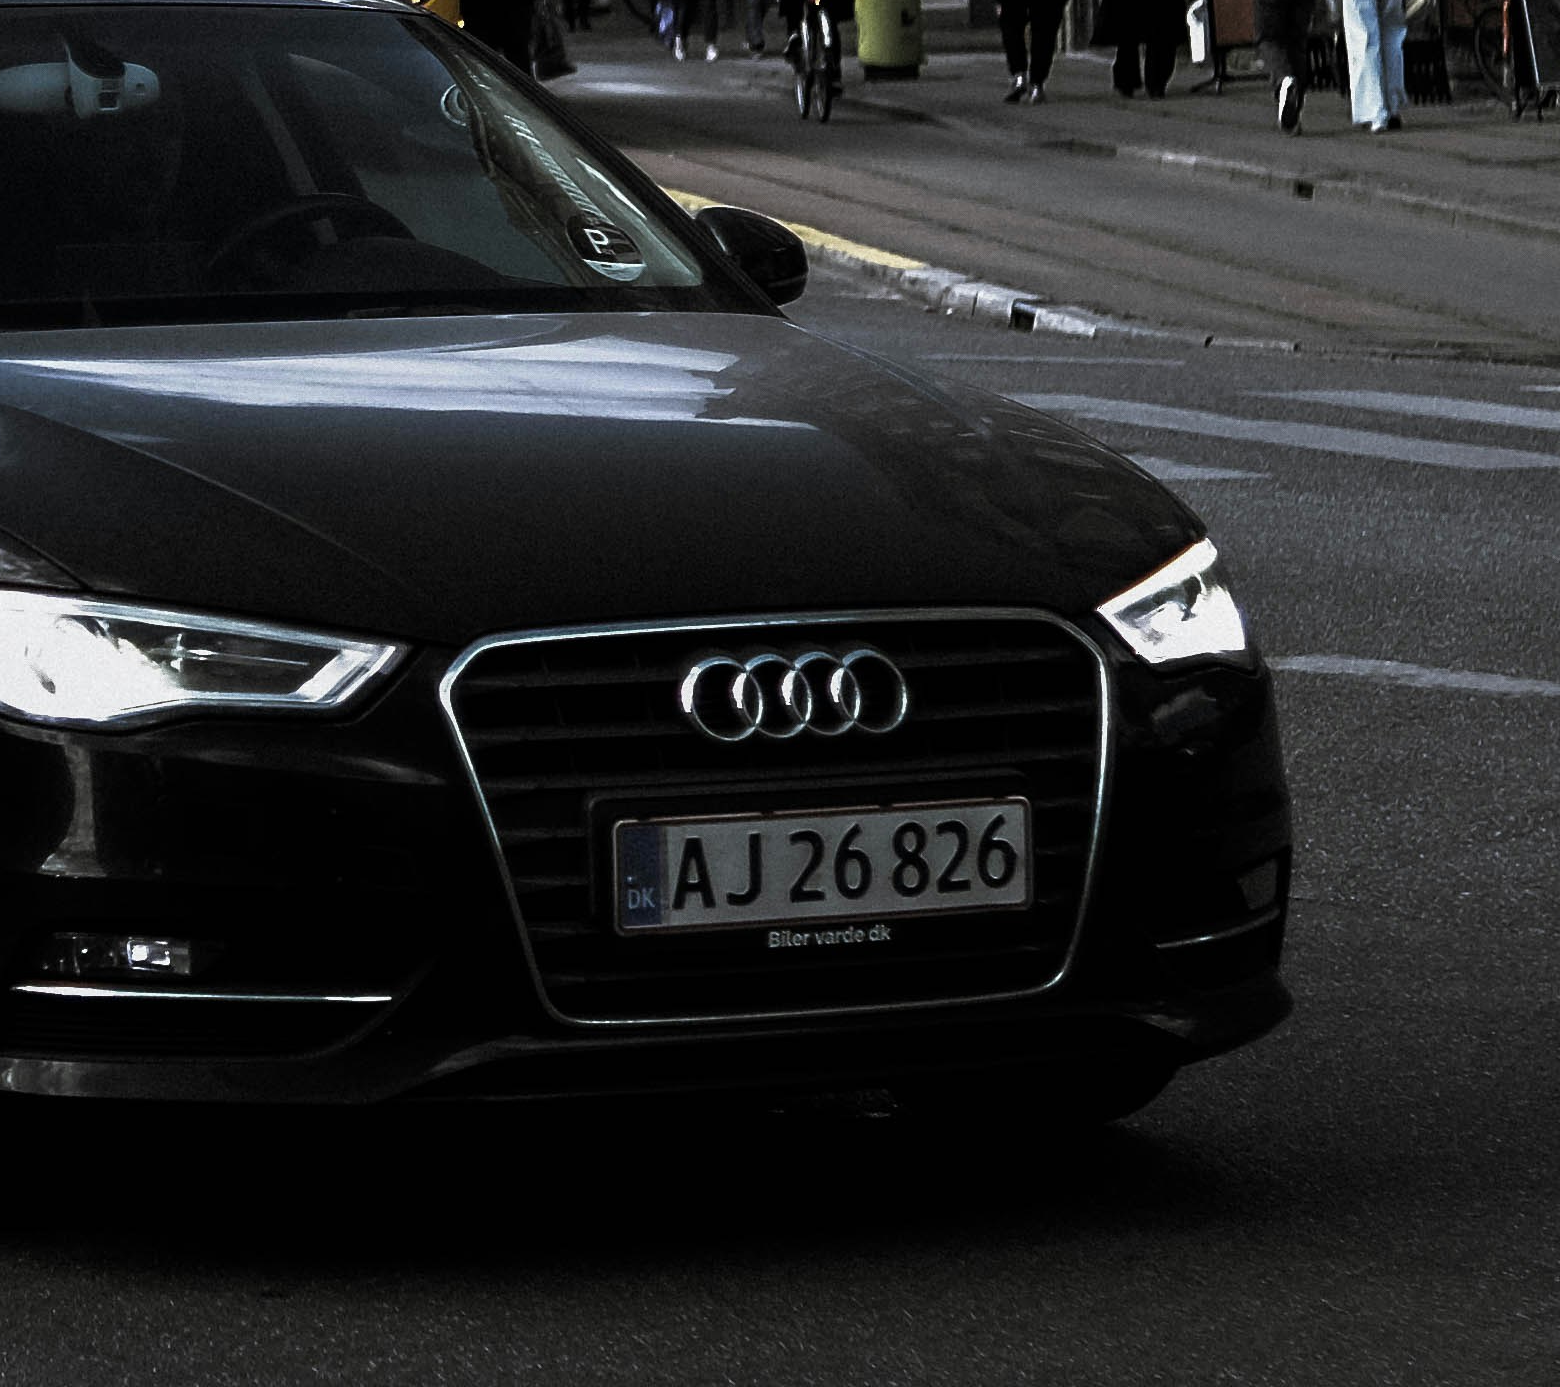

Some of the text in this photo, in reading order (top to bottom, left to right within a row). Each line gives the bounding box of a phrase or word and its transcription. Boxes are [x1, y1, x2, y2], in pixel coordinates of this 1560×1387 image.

[672, 813, 1019, 910] AJ 26 826
[627, 888, 657, 911] DK
